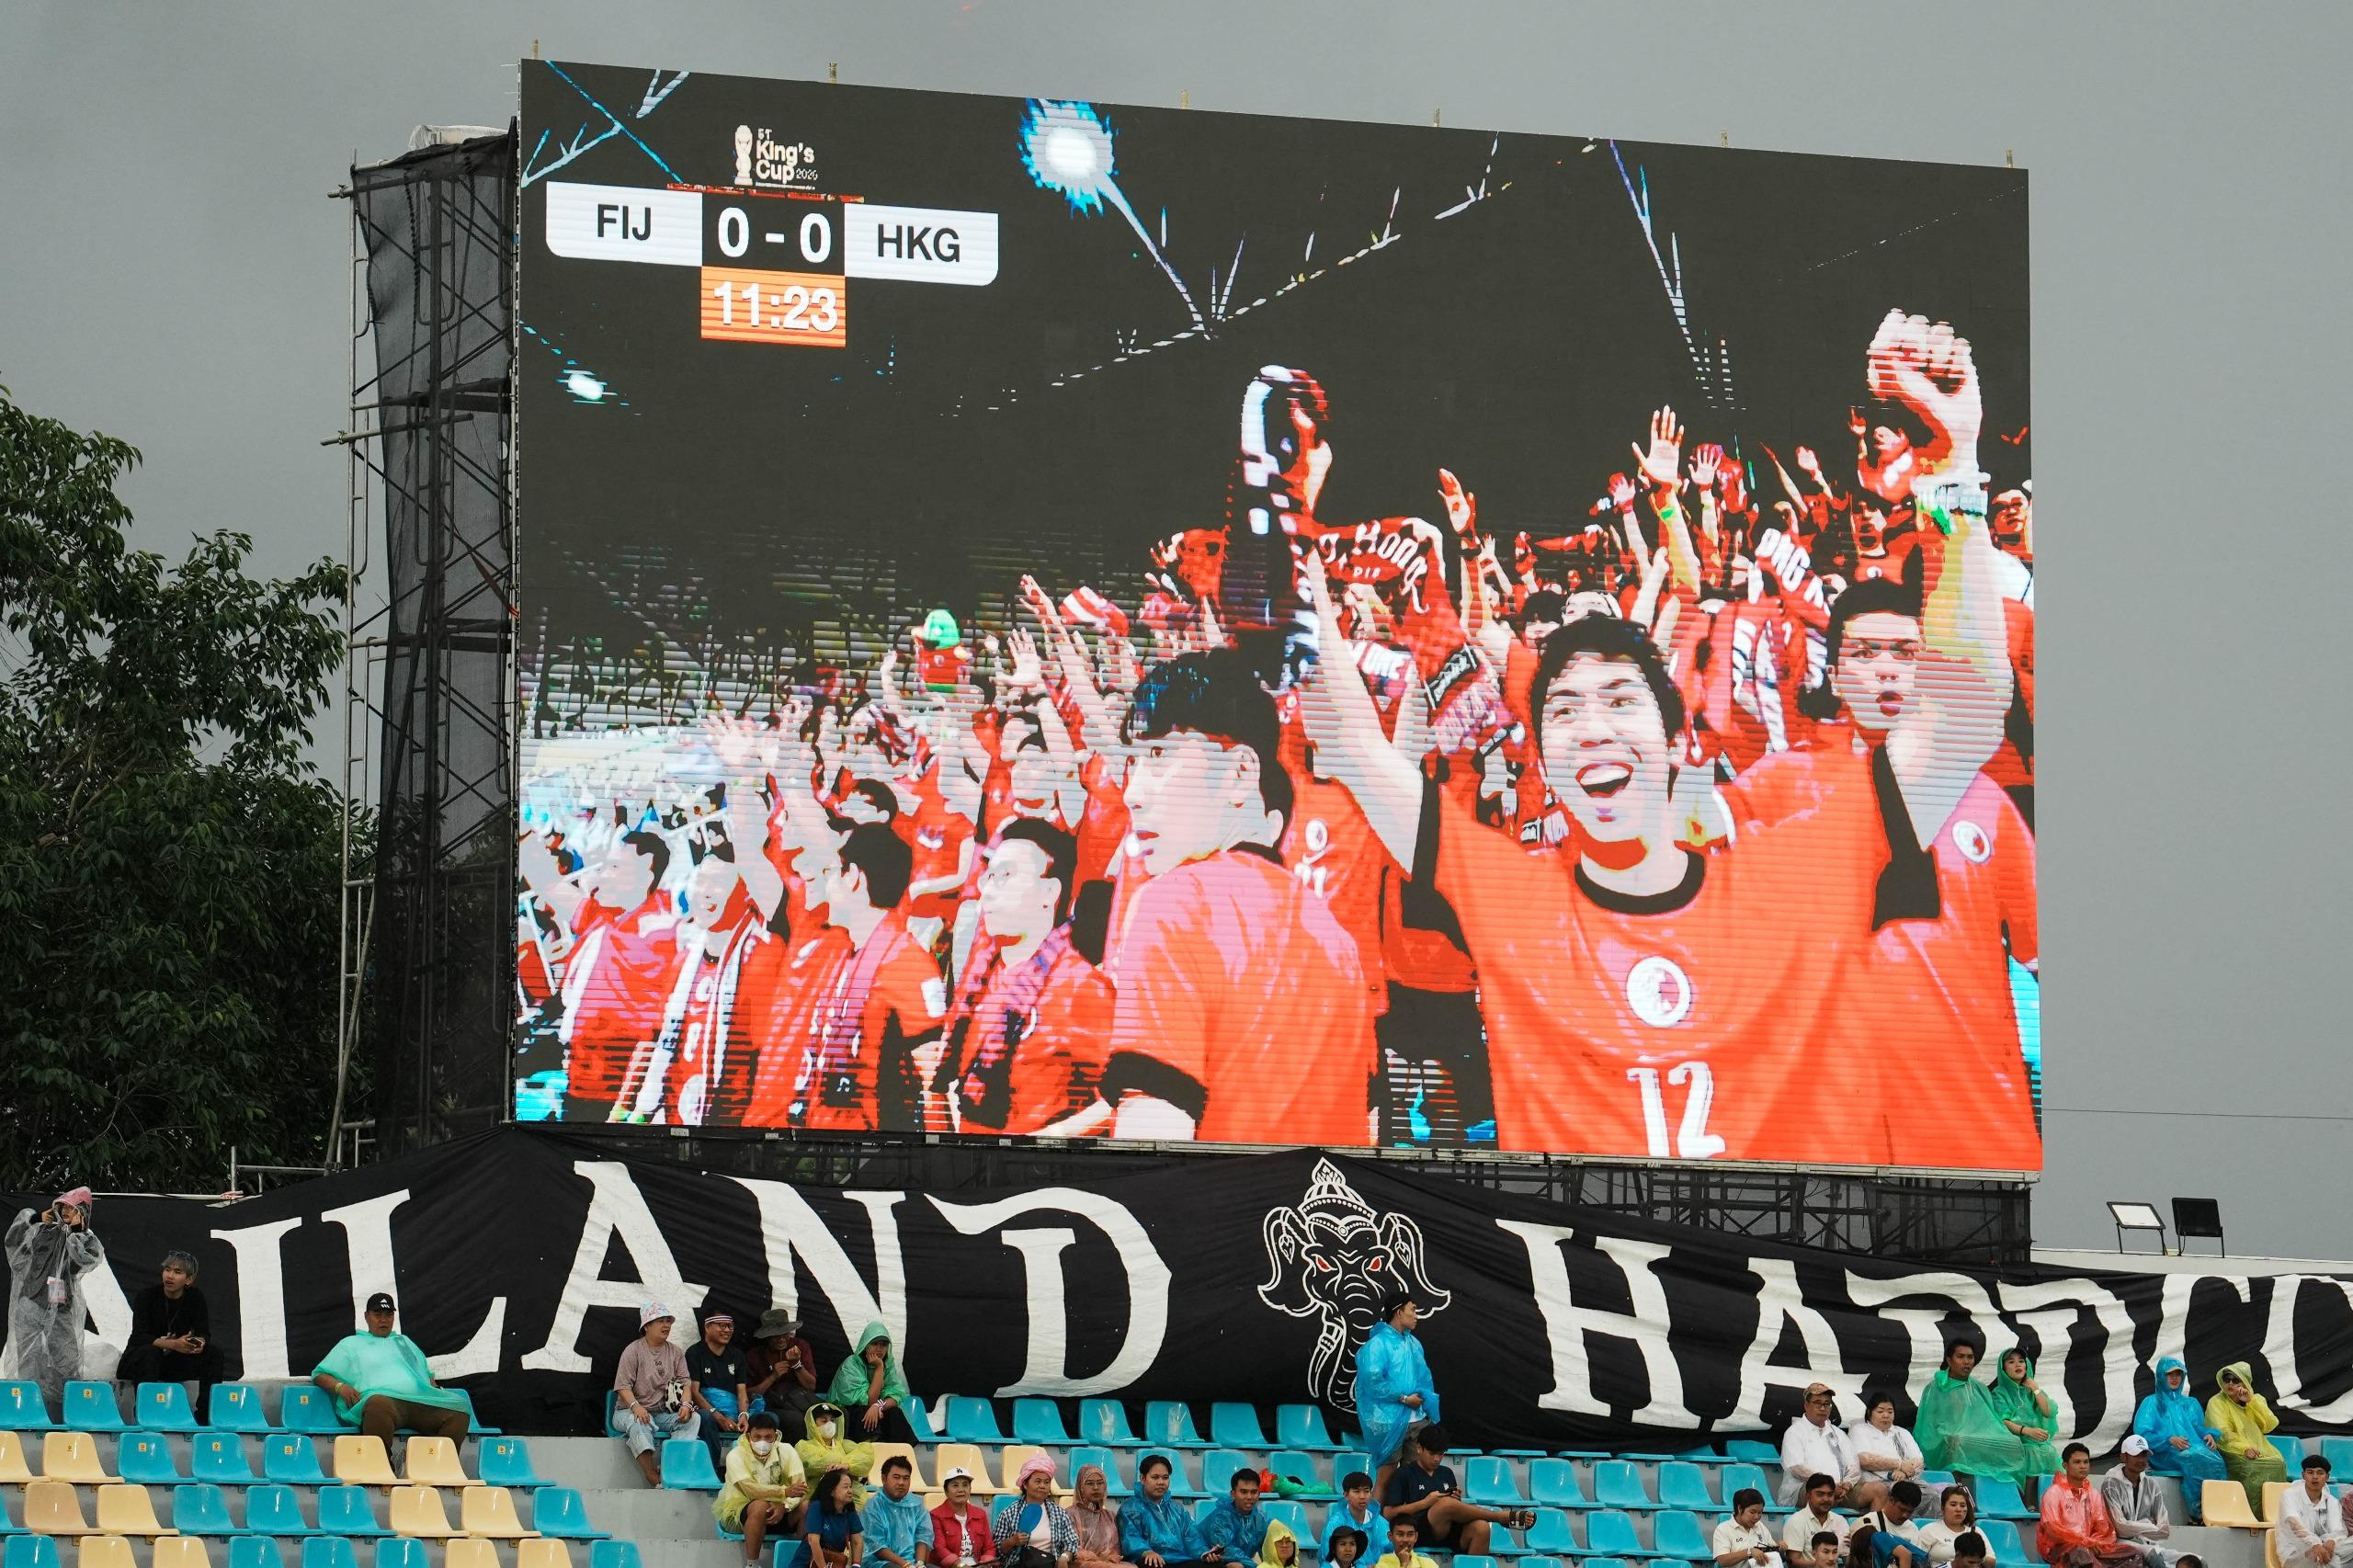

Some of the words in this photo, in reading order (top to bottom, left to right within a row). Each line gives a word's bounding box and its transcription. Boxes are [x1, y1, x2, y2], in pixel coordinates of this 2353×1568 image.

[756, 140, 814, 167] King's
[756, 159, 794, 184] Cup
[597, 203, 652, 241] FIJ
[718, 207, 749, 257] 0
[800, 212, 831, 263] 0
[877, 223, 961, 263] HKG
[713, 281, 838, 332] 11:23
[1626, 1061, 1726, 1158] 12
